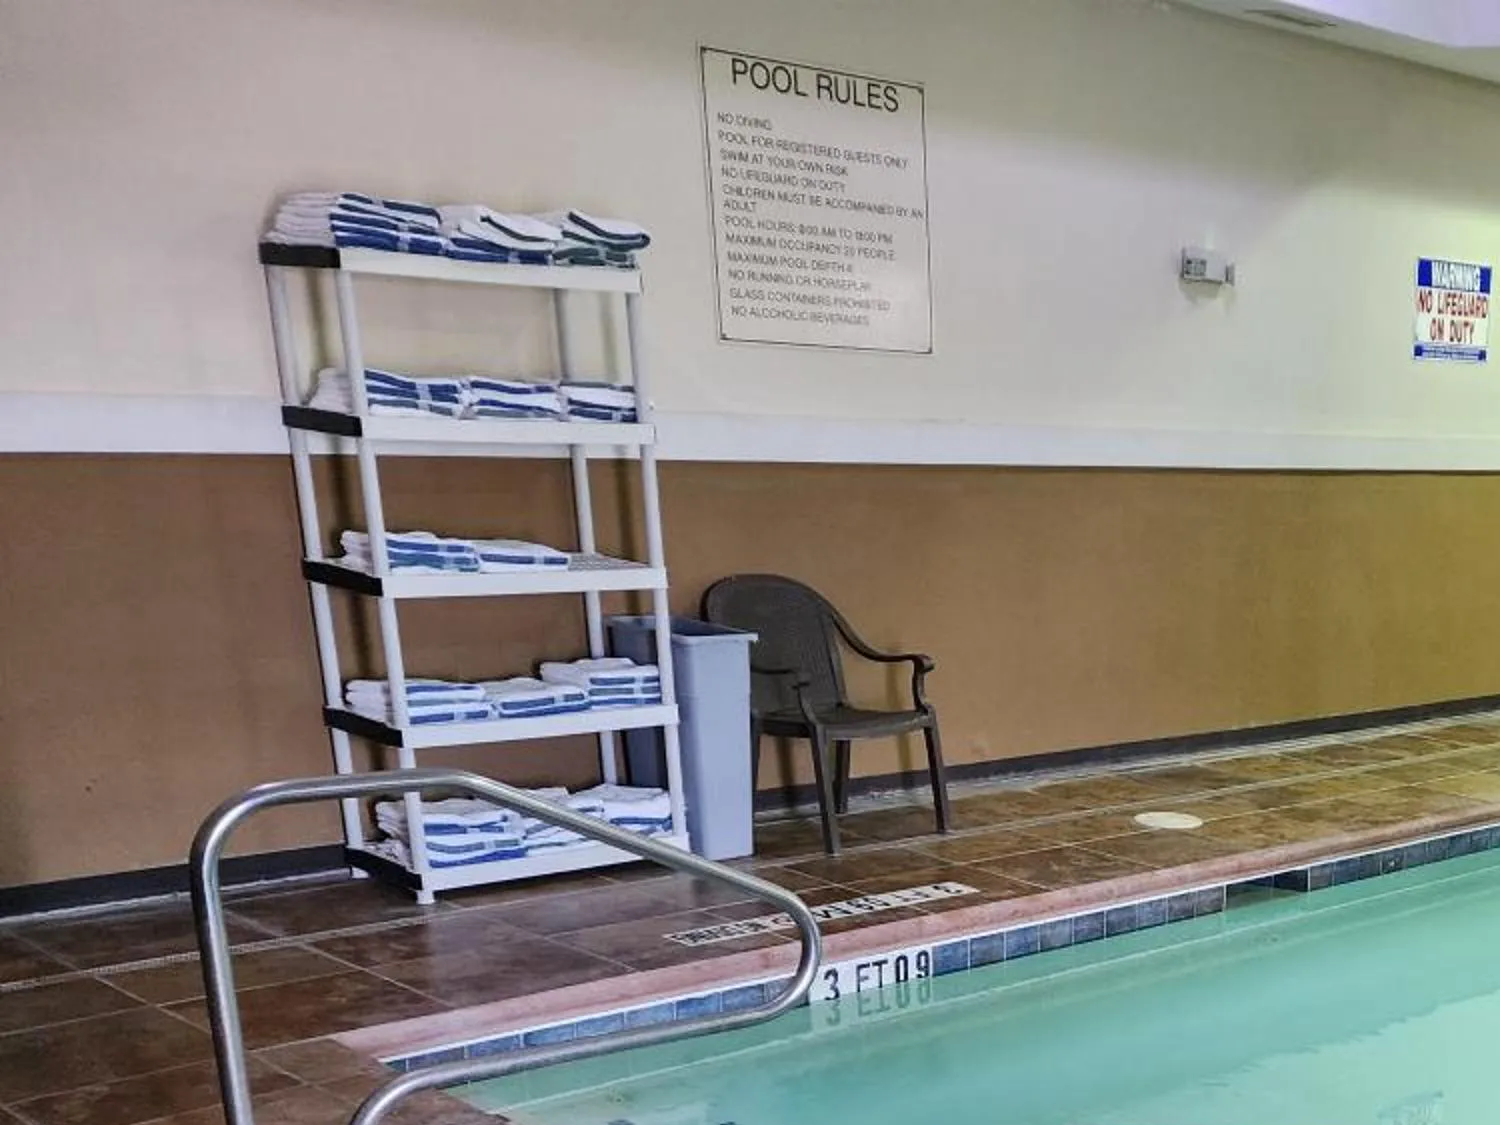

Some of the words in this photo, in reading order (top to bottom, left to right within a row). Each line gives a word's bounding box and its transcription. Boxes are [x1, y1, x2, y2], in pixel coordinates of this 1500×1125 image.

[731, 57, 808, 97] POOL
[815, 73, 899, 112] RULES
[717, 112, 733, 124] NO
[718, 131, 747, 146] POOL
[751, 135, 774, 149] FOR
[884, 154, 909, 170] ONLY
[721, 164, 738, 179] NO
[751, 153, 764, 165] AT
[766, 155, 797, 171] YOUR
[799, 159, 824, 174] OWN
[825, 163, 849, 177] RISK
[724, 215, 756, 229] POOL
[1416, 289, 1433, 314] NO
[1437, 291, 1488, 318] LIFEGUARD
[1429, 317, 1445, 341] ON
[1449, 319, 1475, 344] DUTY
[824, 967, 840, 1001] 3
[856, 958, 888, 992] FT
